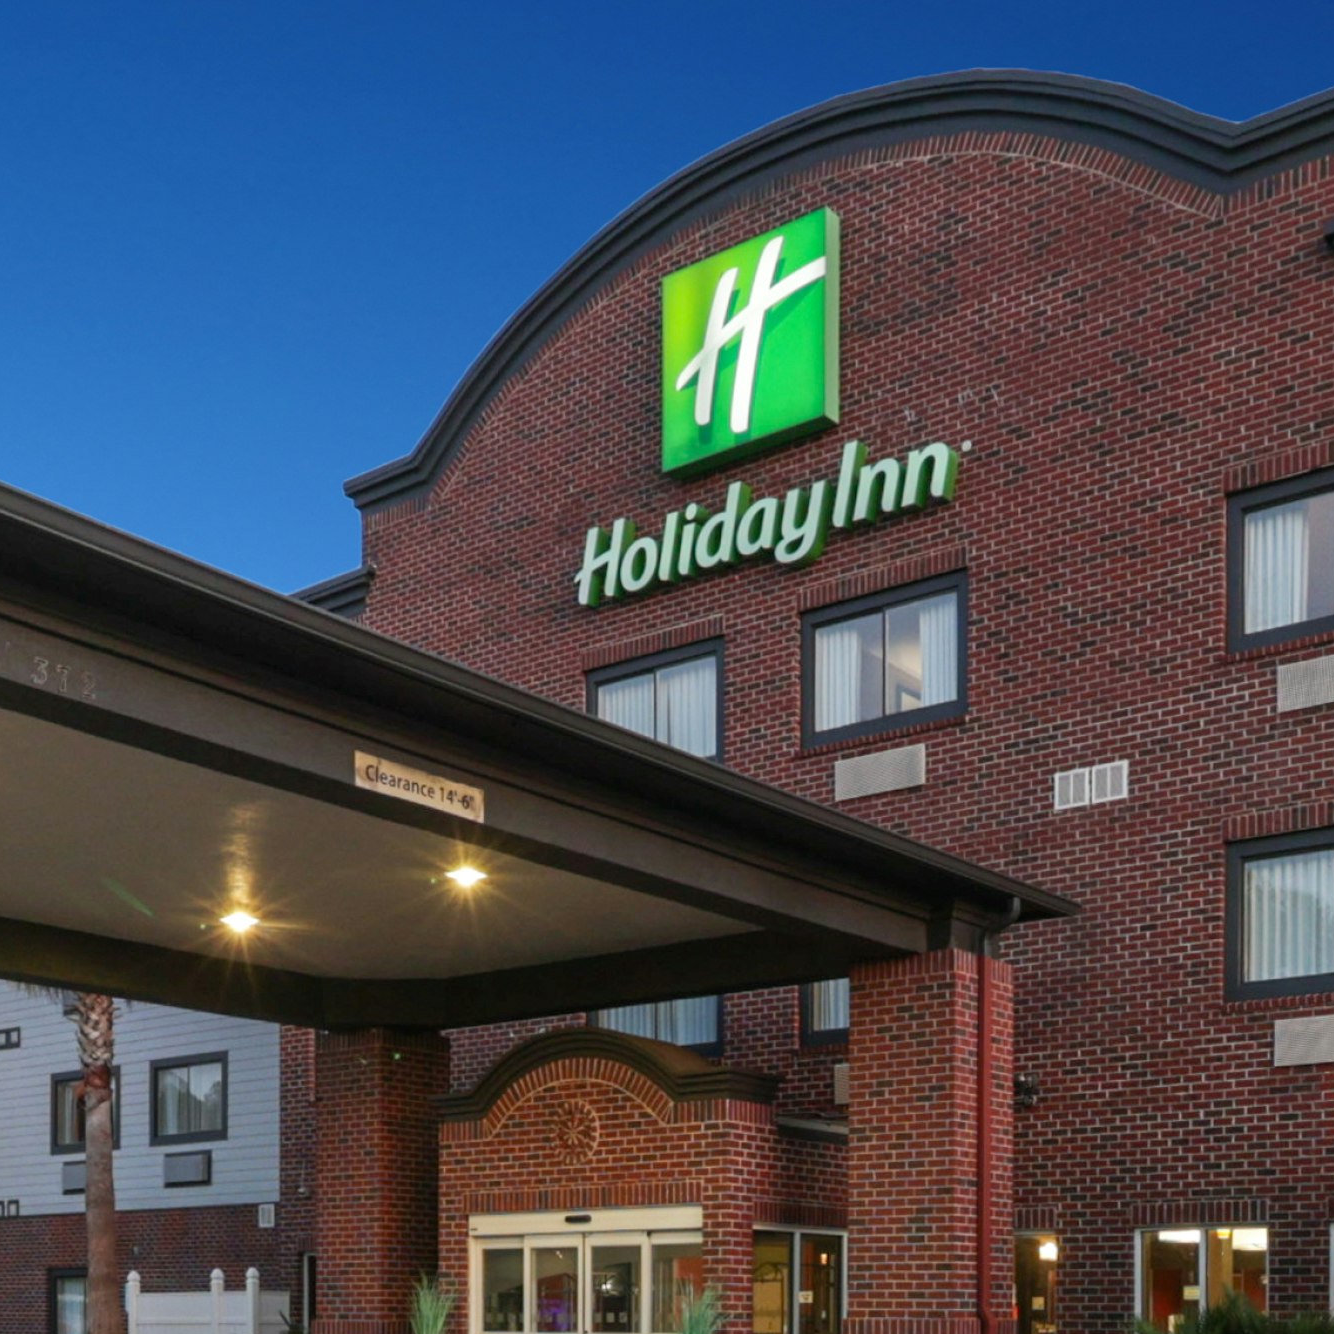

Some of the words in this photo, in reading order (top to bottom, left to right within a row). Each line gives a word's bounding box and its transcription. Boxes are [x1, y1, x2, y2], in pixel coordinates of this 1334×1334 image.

[676, 235, 827, 433] H
[574, 480, 830, 606] Holiday
[832, 440, 955, 528] Inn
[365, 764, 436, 799] Clearance
